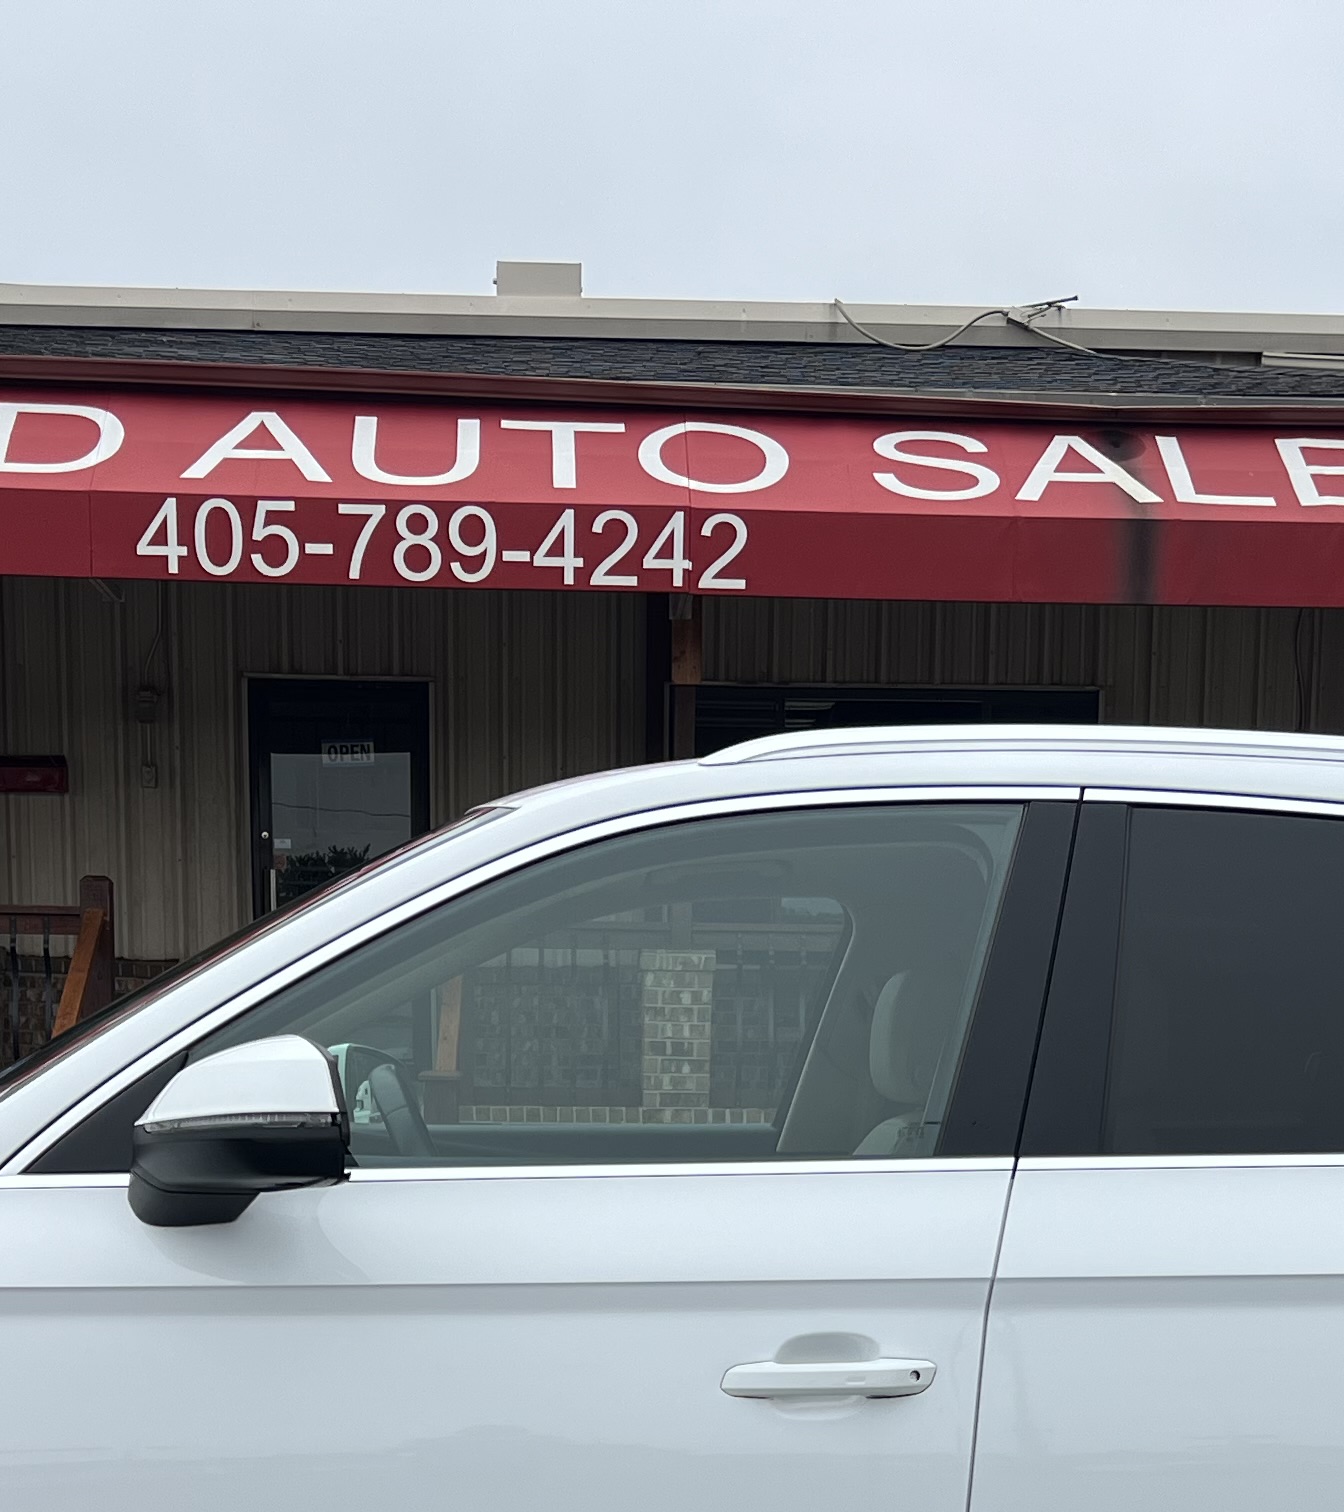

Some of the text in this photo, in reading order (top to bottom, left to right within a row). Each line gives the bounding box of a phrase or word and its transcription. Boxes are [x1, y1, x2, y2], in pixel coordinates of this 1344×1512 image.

[179, 411, 791, 495] AUTO
[136, 497, 748, 590] 405-789-4242
[327, 743, 371, 762] OPEN
